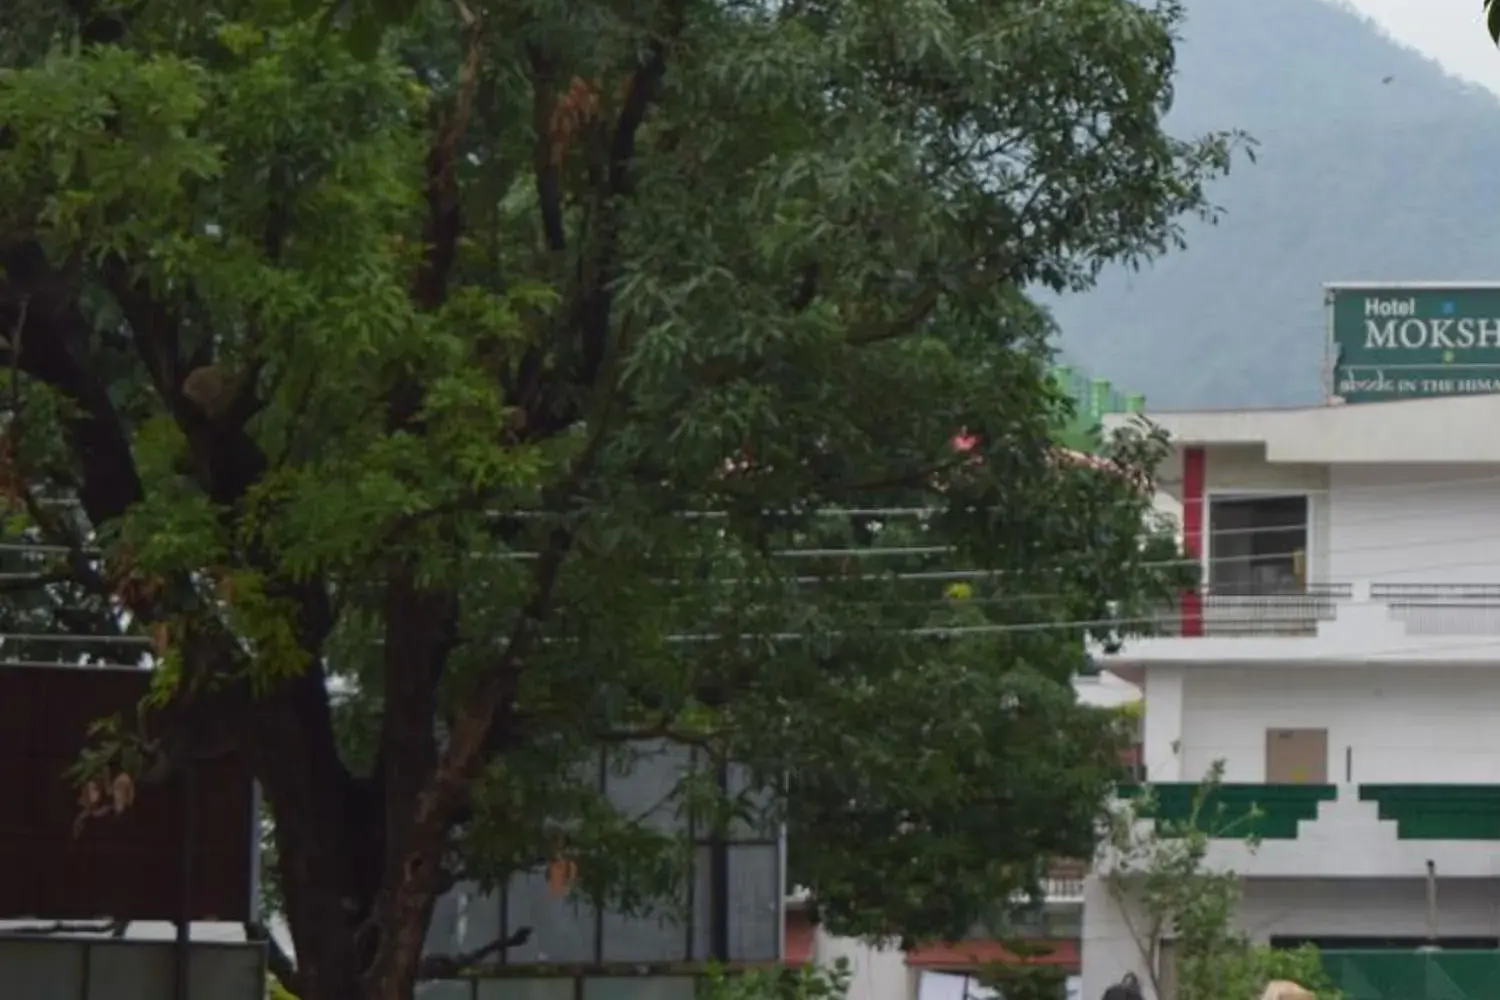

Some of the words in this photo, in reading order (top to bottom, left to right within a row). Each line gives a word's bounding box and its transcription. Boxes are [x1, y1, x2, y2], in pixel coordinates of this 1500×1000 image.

[1364, 298, 1415, 316] Hotel
[1398, 379, 1417, 392] IN
[1423, 379, 1452, 392] THE
